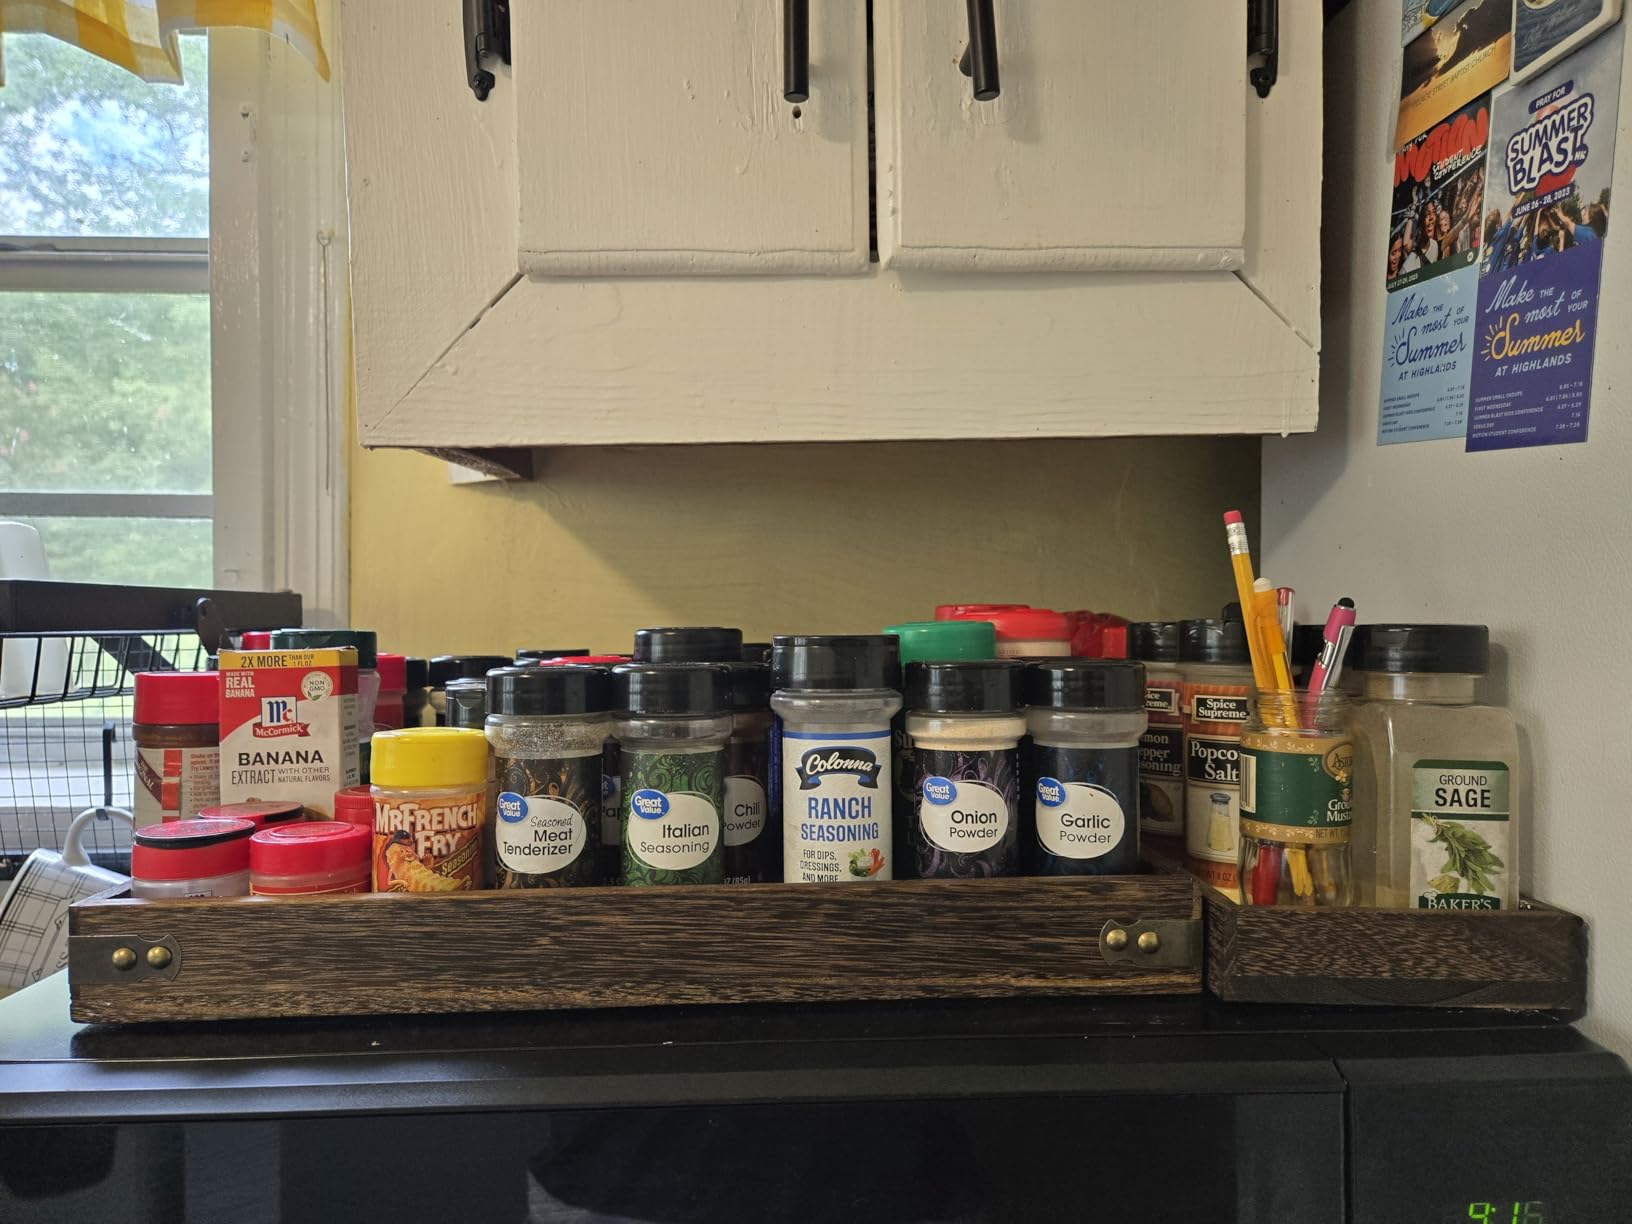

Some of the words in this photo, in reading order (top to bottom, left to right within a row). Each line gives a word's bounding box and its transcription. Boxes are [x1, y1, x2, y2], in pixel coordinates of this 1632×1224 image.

[1536, 94, 1552, 109] PRAY
[1552, 86, 1566, 100] FOR
[1510, 102, 1589, 163] SUMMER
[1432, 148, 1464, 174] STUDENT
[1434, 144, 1483, 180] CONFERENCE
[1512, 124, 1584, 187] BLAST
[1514, 201, 1531, 216] JUNE
[1531, 198, 1539, 210] 26
[1554, 186, 1570, 201] 2023
[1485, 274, 1534, 314] Make
[1540, 286, 1554, 298] THE
[1571, 289, 1582, 300] OF
[1392, 292, 1429, 325] Make
[1432, 304, 1444, 312] THE
[1456, 306, 1464, 315] OF
[1524, 291, 1565, 324] most
[1568, 300, 1588, 312] YOUR
[1421, 308, 1452, 335] most
[1454, 316, 1469, 326] YOUR
[1491, 312, 1586, 360] Summer
[1396, 326, 1466, 366] Summer
[1495, 366, 1508, 377] AT
[1512, 353, 1572, 374] HIGHLANDS
[1398, 372, 1408, 381] AT
[241, 656, 254, 668] 2X
[256, 655, 288, 668] MORE
[226, 677, 254, 688] REAL
[225, 689, 256, 698] BANANA
[1206, 699, 1236, 710] Spice
[1198, 706, 1247, 718] Supreme
[255, 724, 304, 738] McCormick
[1144, 735, 1169, 744] mon
[238, 750, 324, 766] BANANA
[806, 752, 874, 775] Colonna
[232, 770, 276, 784] EXTRACT
[1205, 762, 1240, 782] Salt
[1440, 775, 1488, 786] GROUND
[926, 782, 950, 794] Great
[1038, 782, 1060, 796] Great
[500, 798, 520, 811] Great
[634, 796, 662, 807] Great
[1042, 794, 1060, 802] Value
[1434, 788, 1491, 808] SAGE
[504, 808, 520, 817] Value
[640, 805, 662, 814] Value
[734, 802, 760, 817] Chili
[808, 796, 872, 820] RANCH
[530, 813, 574, 828] Seasoned
[951, 810, 998, 824] Onion
[1060, 814, 1111, 829] Garlic
[534, 828, 573, 842] Meat
[662, 824, 710, 838] Italian
[801, 822, 879, 842] SEASONING
[950, 827, 998, 838] Powder
[1060, 830, 1112, 844] Powder
[416, 830, 461, 859] FRY
[504, 842, 572, 856] Tenderizer
[640, 841, 710, 854] Seasoning
[803, 849, 816, 860] FOR
[817, 850, 837, 861] DIPS,
[800, 860, 842, 872] DRESSINGS,
[802, 872, 816, 882] AND
[1428, 898, 1492, 910] BAKER'S
